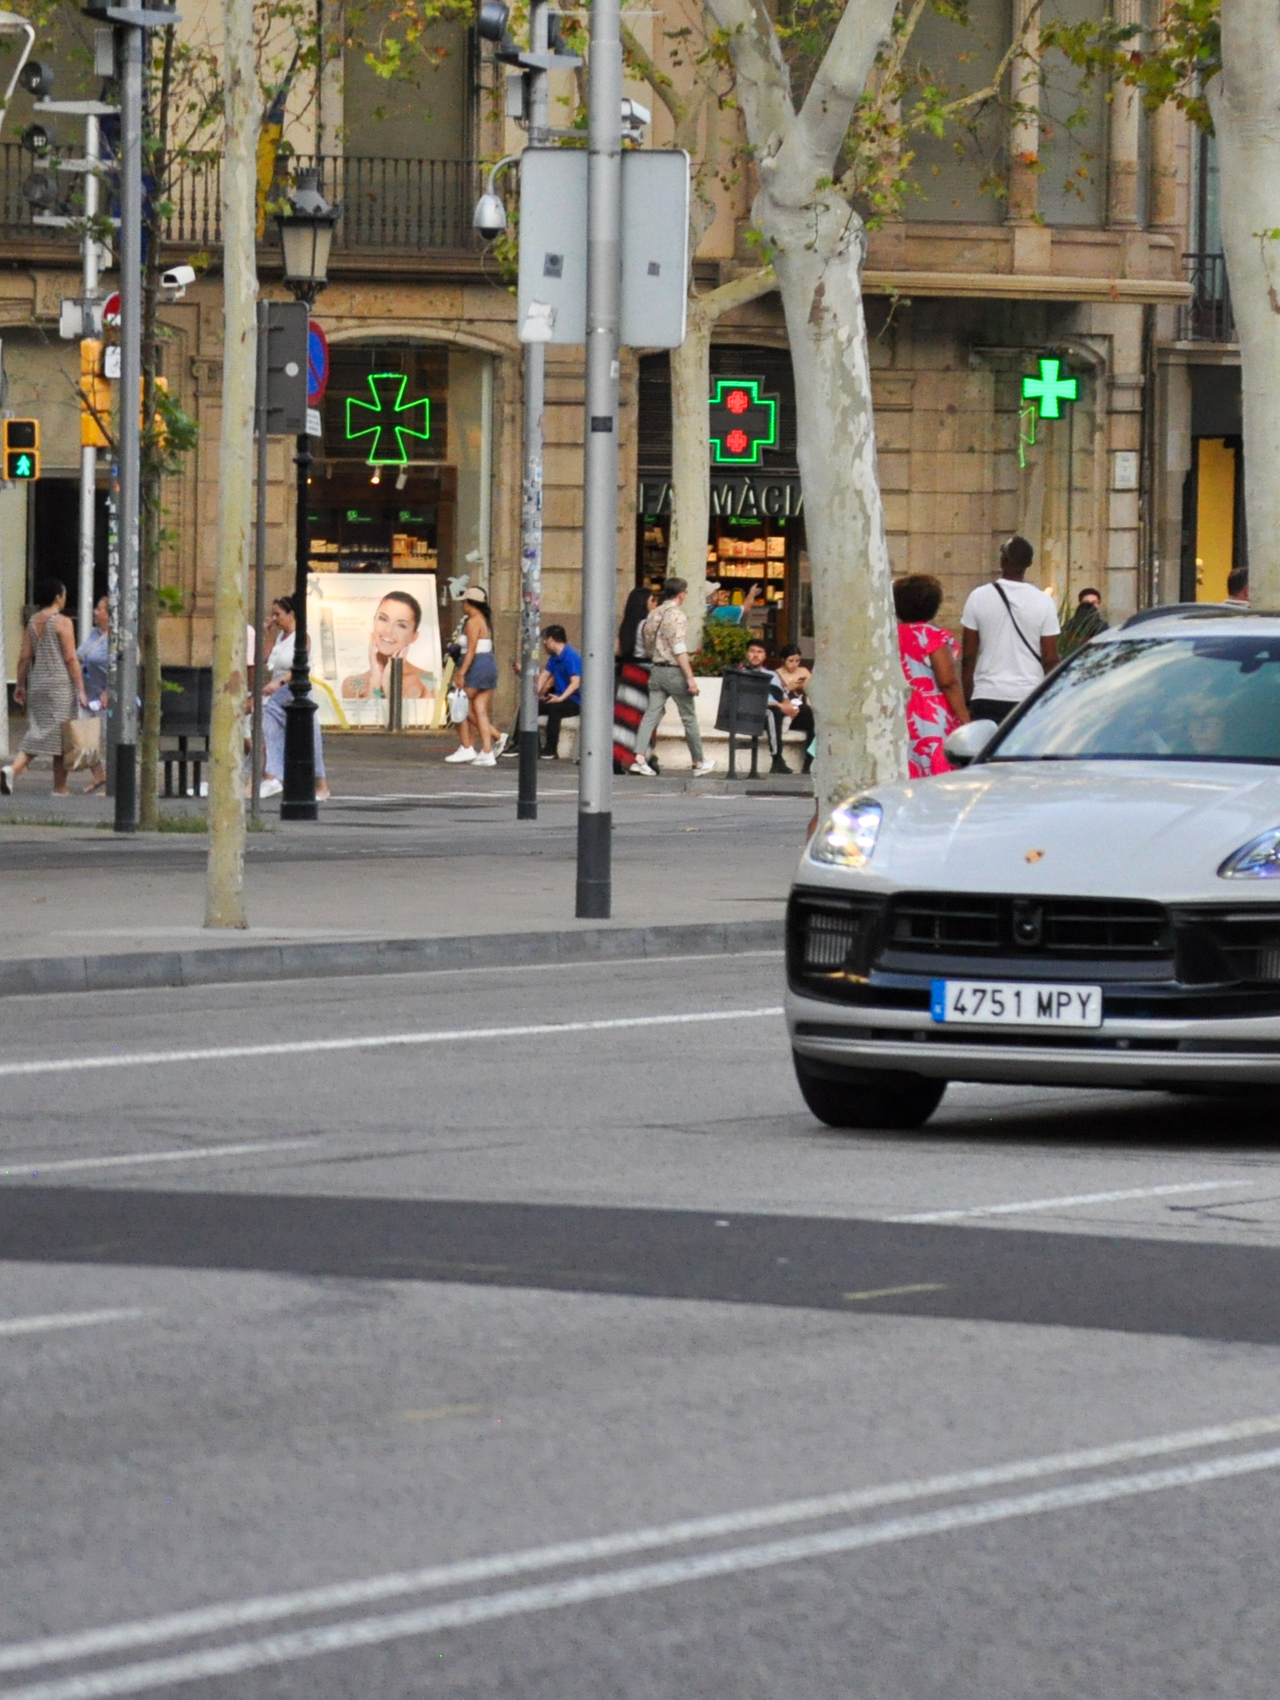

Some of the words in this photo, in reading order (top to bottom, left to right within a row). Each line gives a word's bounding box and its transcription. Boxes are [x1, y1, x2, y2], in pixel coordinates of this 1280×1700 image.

[638, 476, 804, 517] FAMÀCI
[953, 988, 1022, 1018] 4751
[1036, 990, 1093, 1020] MPY
